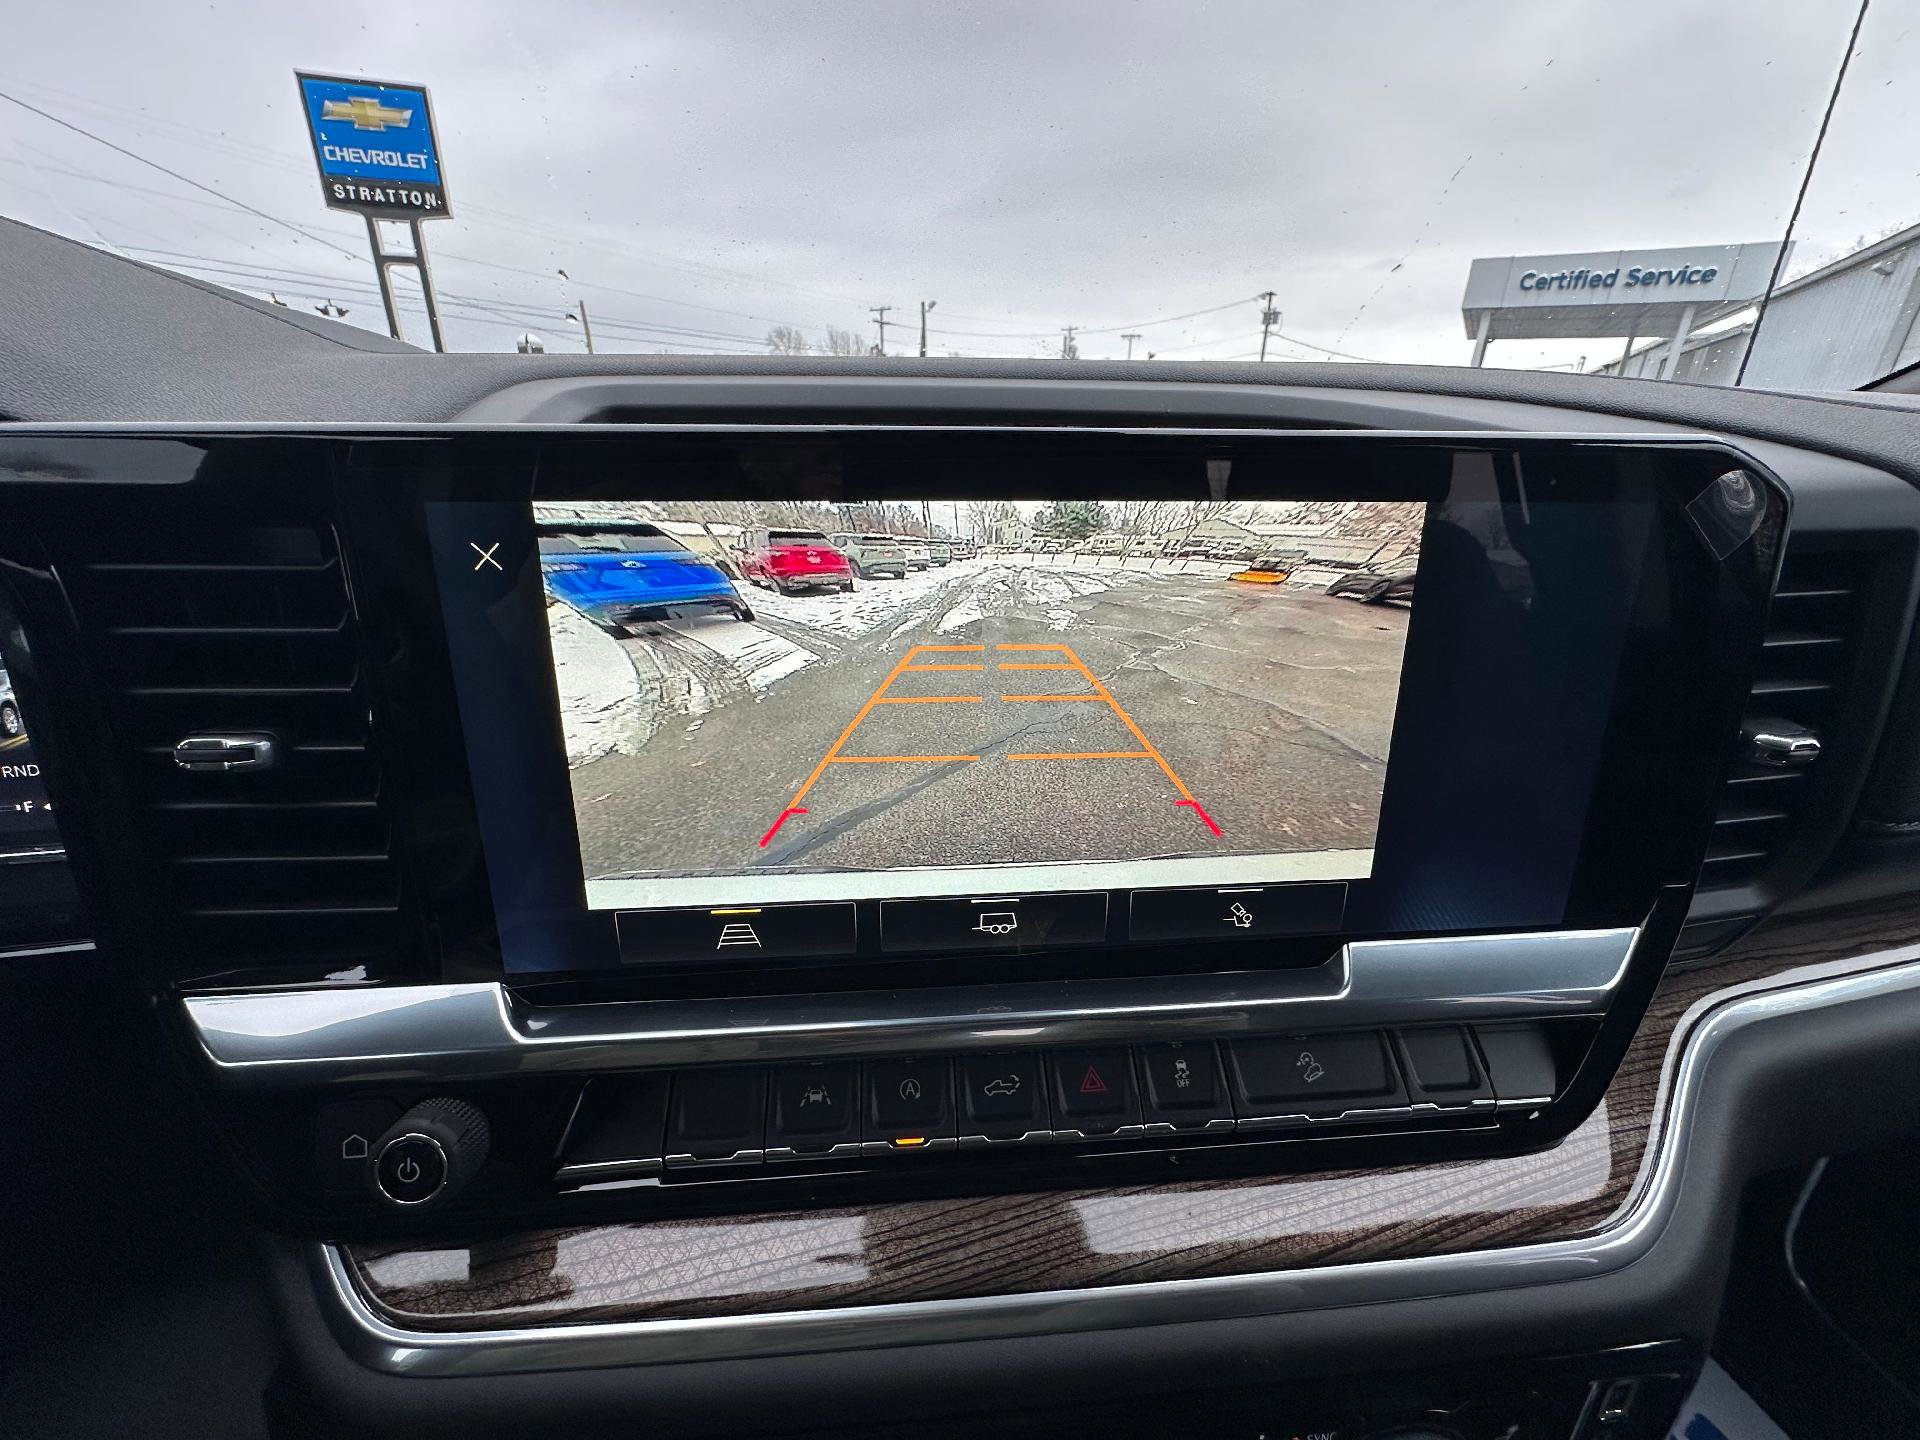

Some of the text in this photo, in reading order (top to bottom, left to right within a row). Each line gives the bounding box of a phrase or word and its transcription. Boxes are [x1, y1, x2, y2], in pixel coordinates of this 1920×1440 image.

[323, 144, 428, 169] CHEVROLET
[333, 183, 437, 208] STRATTON
[1519, 264, 1718, 291] Certified Service
